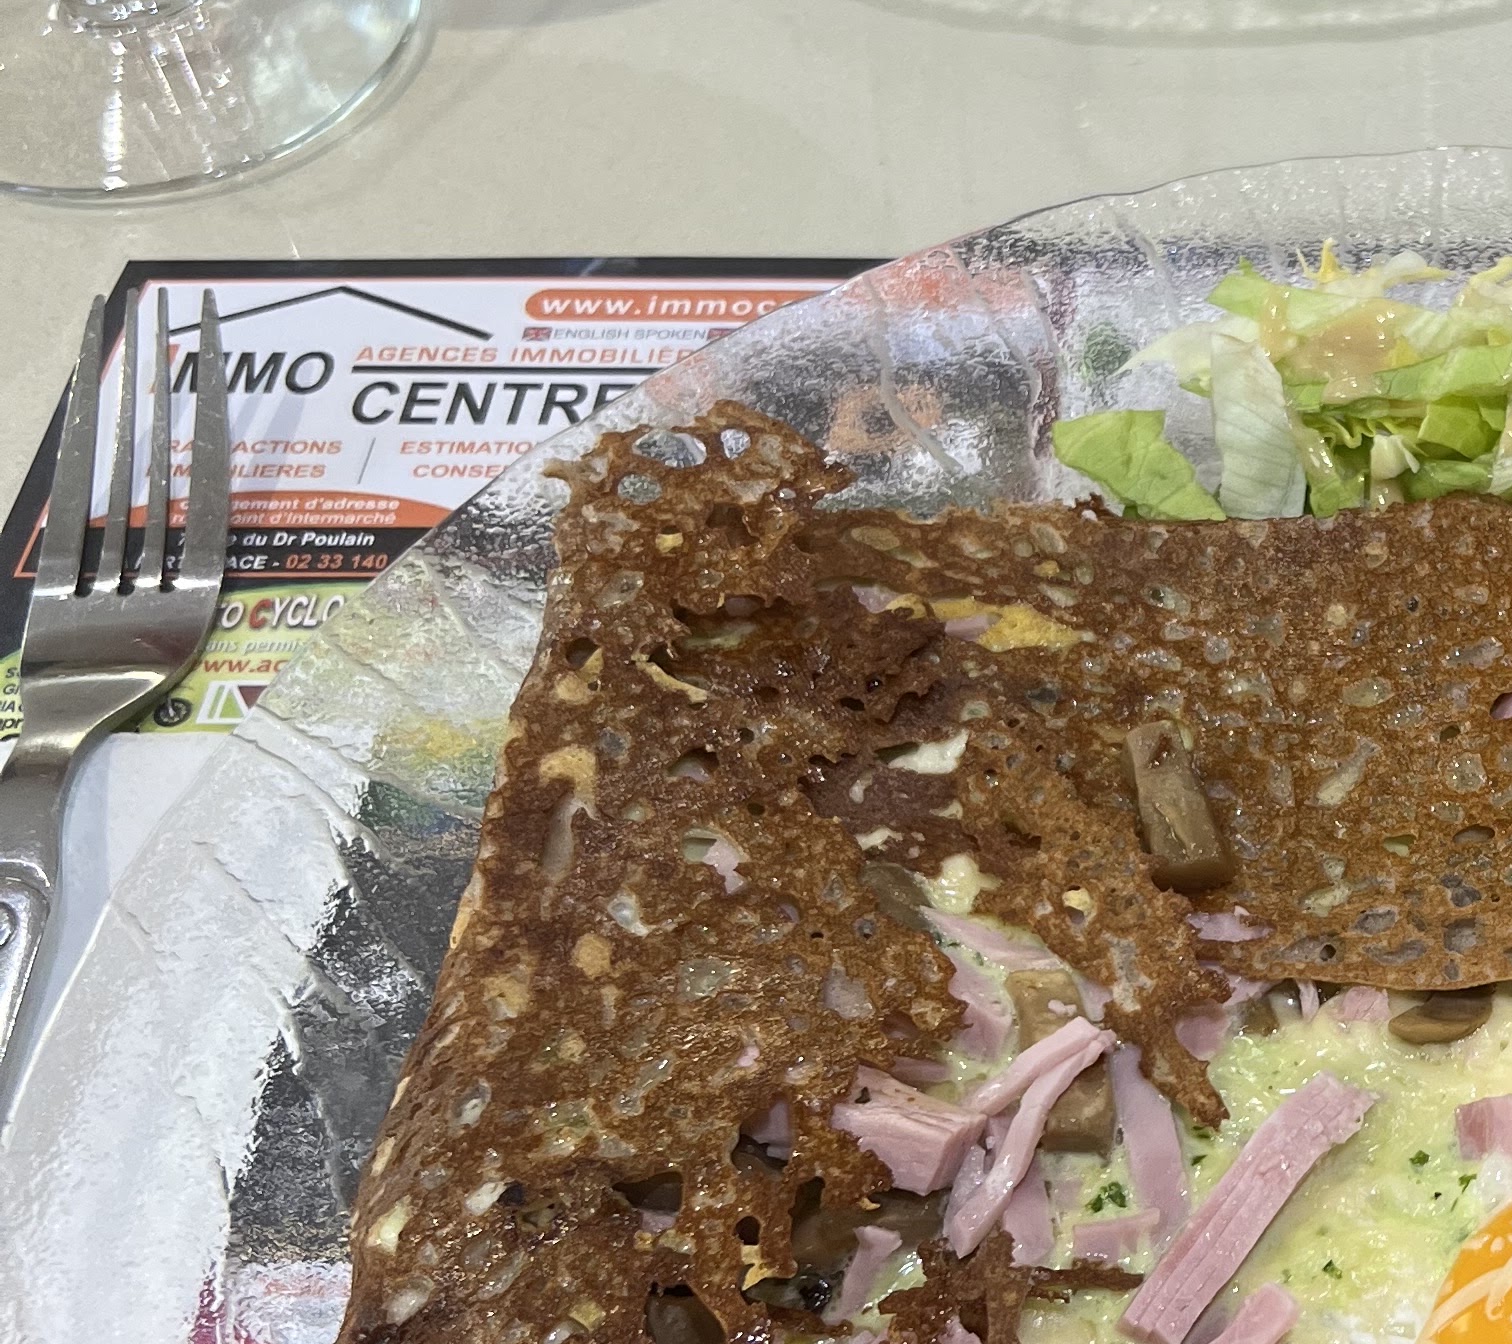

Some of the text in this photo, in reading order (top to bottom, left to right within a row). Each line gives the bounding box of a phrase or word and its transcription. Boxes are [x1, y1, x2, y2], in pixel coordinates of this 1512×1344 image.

[540, 294, 792, 316] www.immoc
[554, 328, 707, 341] ENGLISH SPOKEN
[356, 345, 498, 363] AGENCES
[400, 441, 539, 455] ESTIMATIO
[304, 497, 400, 510] d'adresse
[243, 532, 268, 547] du
[272, 532, 298, 547] Dr
[300, 532, 376, 547] Poulain
[285, 554, 309, 570] 02
[317, 554, 343, 570] 33
[352, 554, 389, 570] 140
